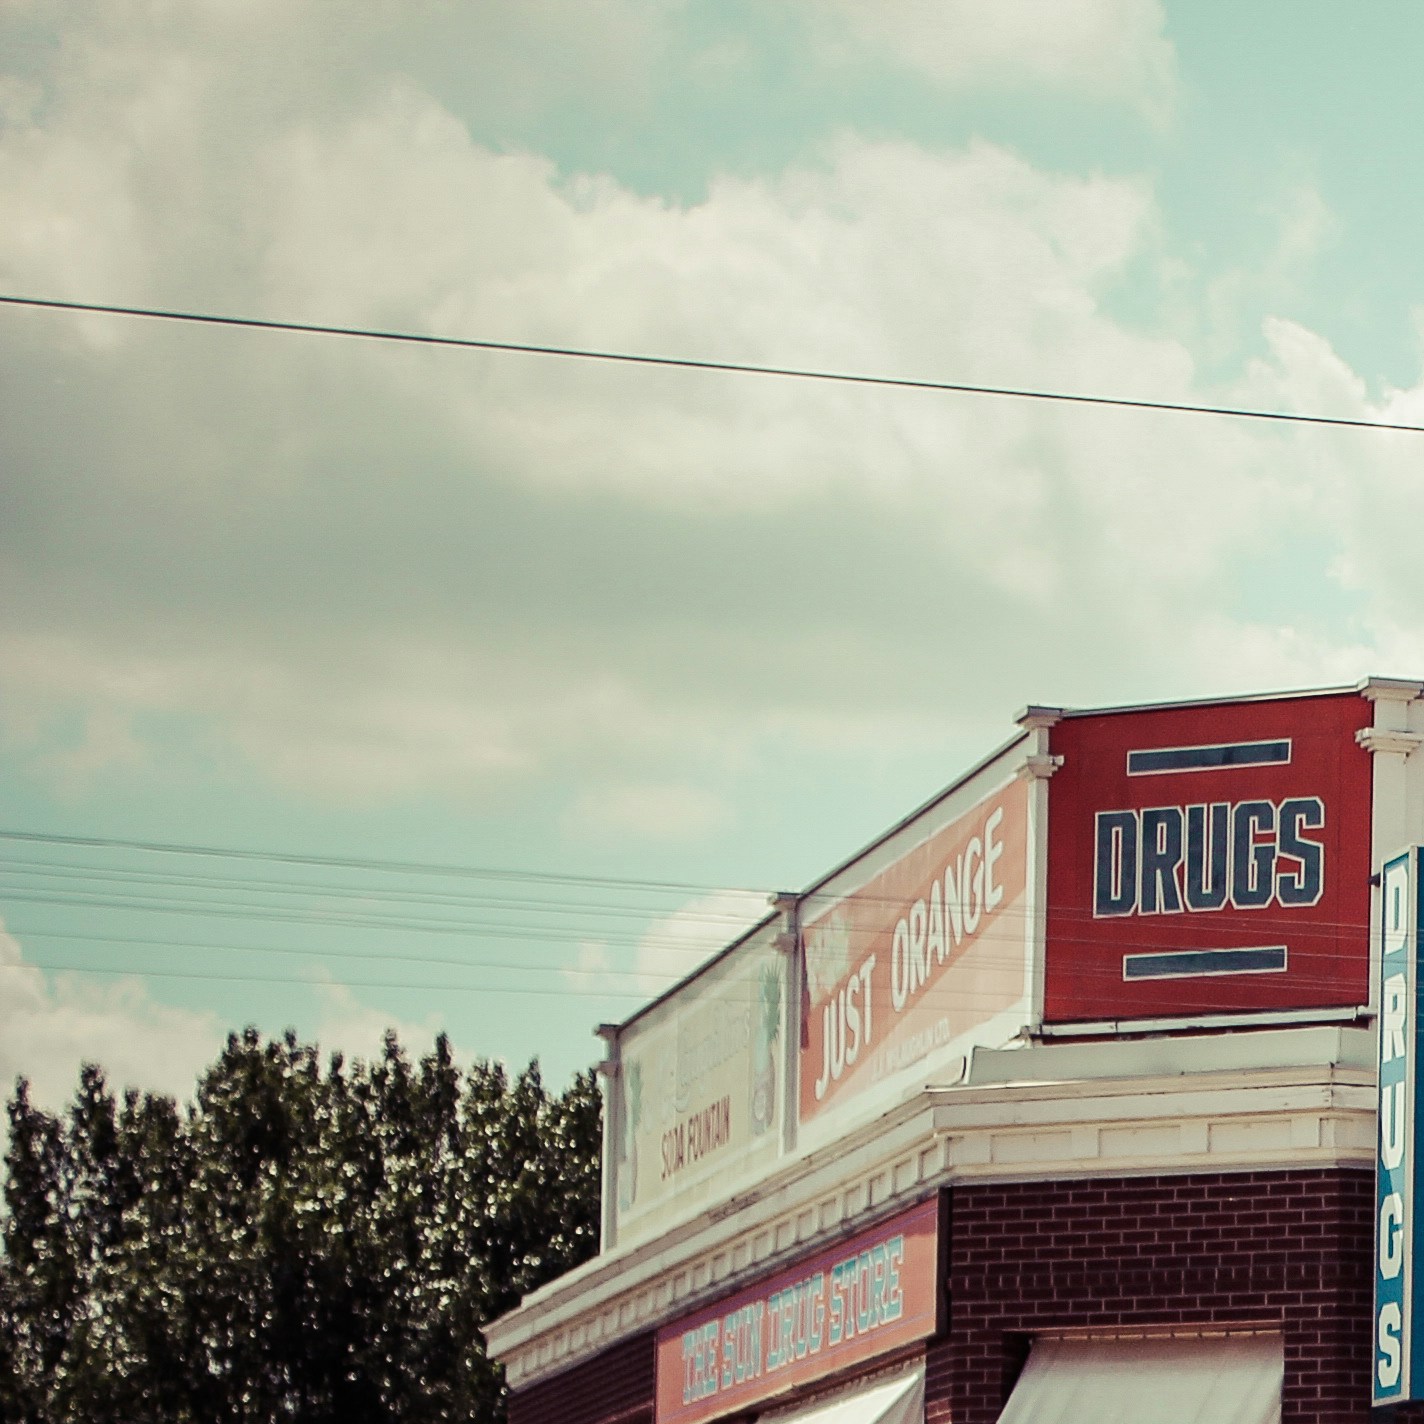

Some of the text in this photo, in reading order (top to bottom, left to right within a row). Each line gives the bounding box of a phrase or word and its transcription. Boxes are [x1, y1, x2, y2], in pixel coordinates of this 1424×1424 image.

[815, 953, 876, 1100] JUST
[891, 806, 1004, 1012] ORANGE
[1092, 795, 1326, 918] DRUGS
[1377, 861, 1408, 1389] DRUGS
[682, 1235, 904, 1406] THE SUN DRUG STORE
